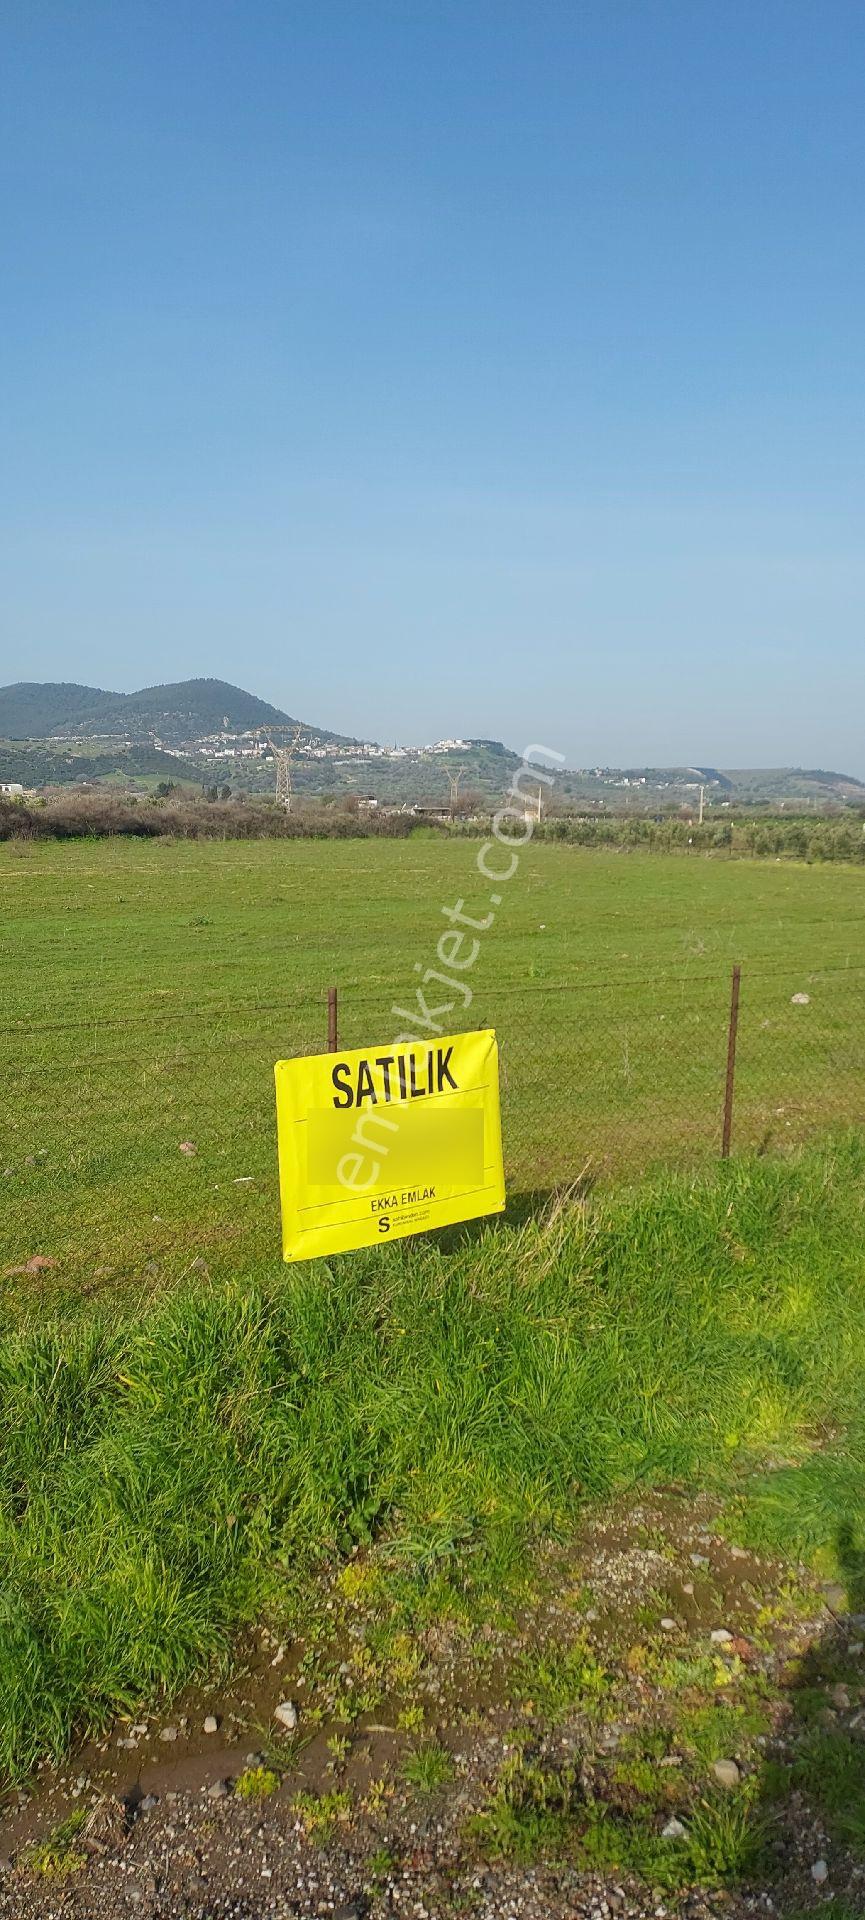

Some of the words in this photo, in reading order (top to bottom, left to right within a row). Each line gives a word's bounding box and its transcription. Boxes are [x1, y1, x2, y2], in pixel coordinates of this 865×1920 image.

[332, 1046, 458, 1109] SATILIK
[371, 1195, 398, 1212] EKKA
[402, 1186, 436, 1204] EMLAK
[378, 1216, 390, 1233] S
